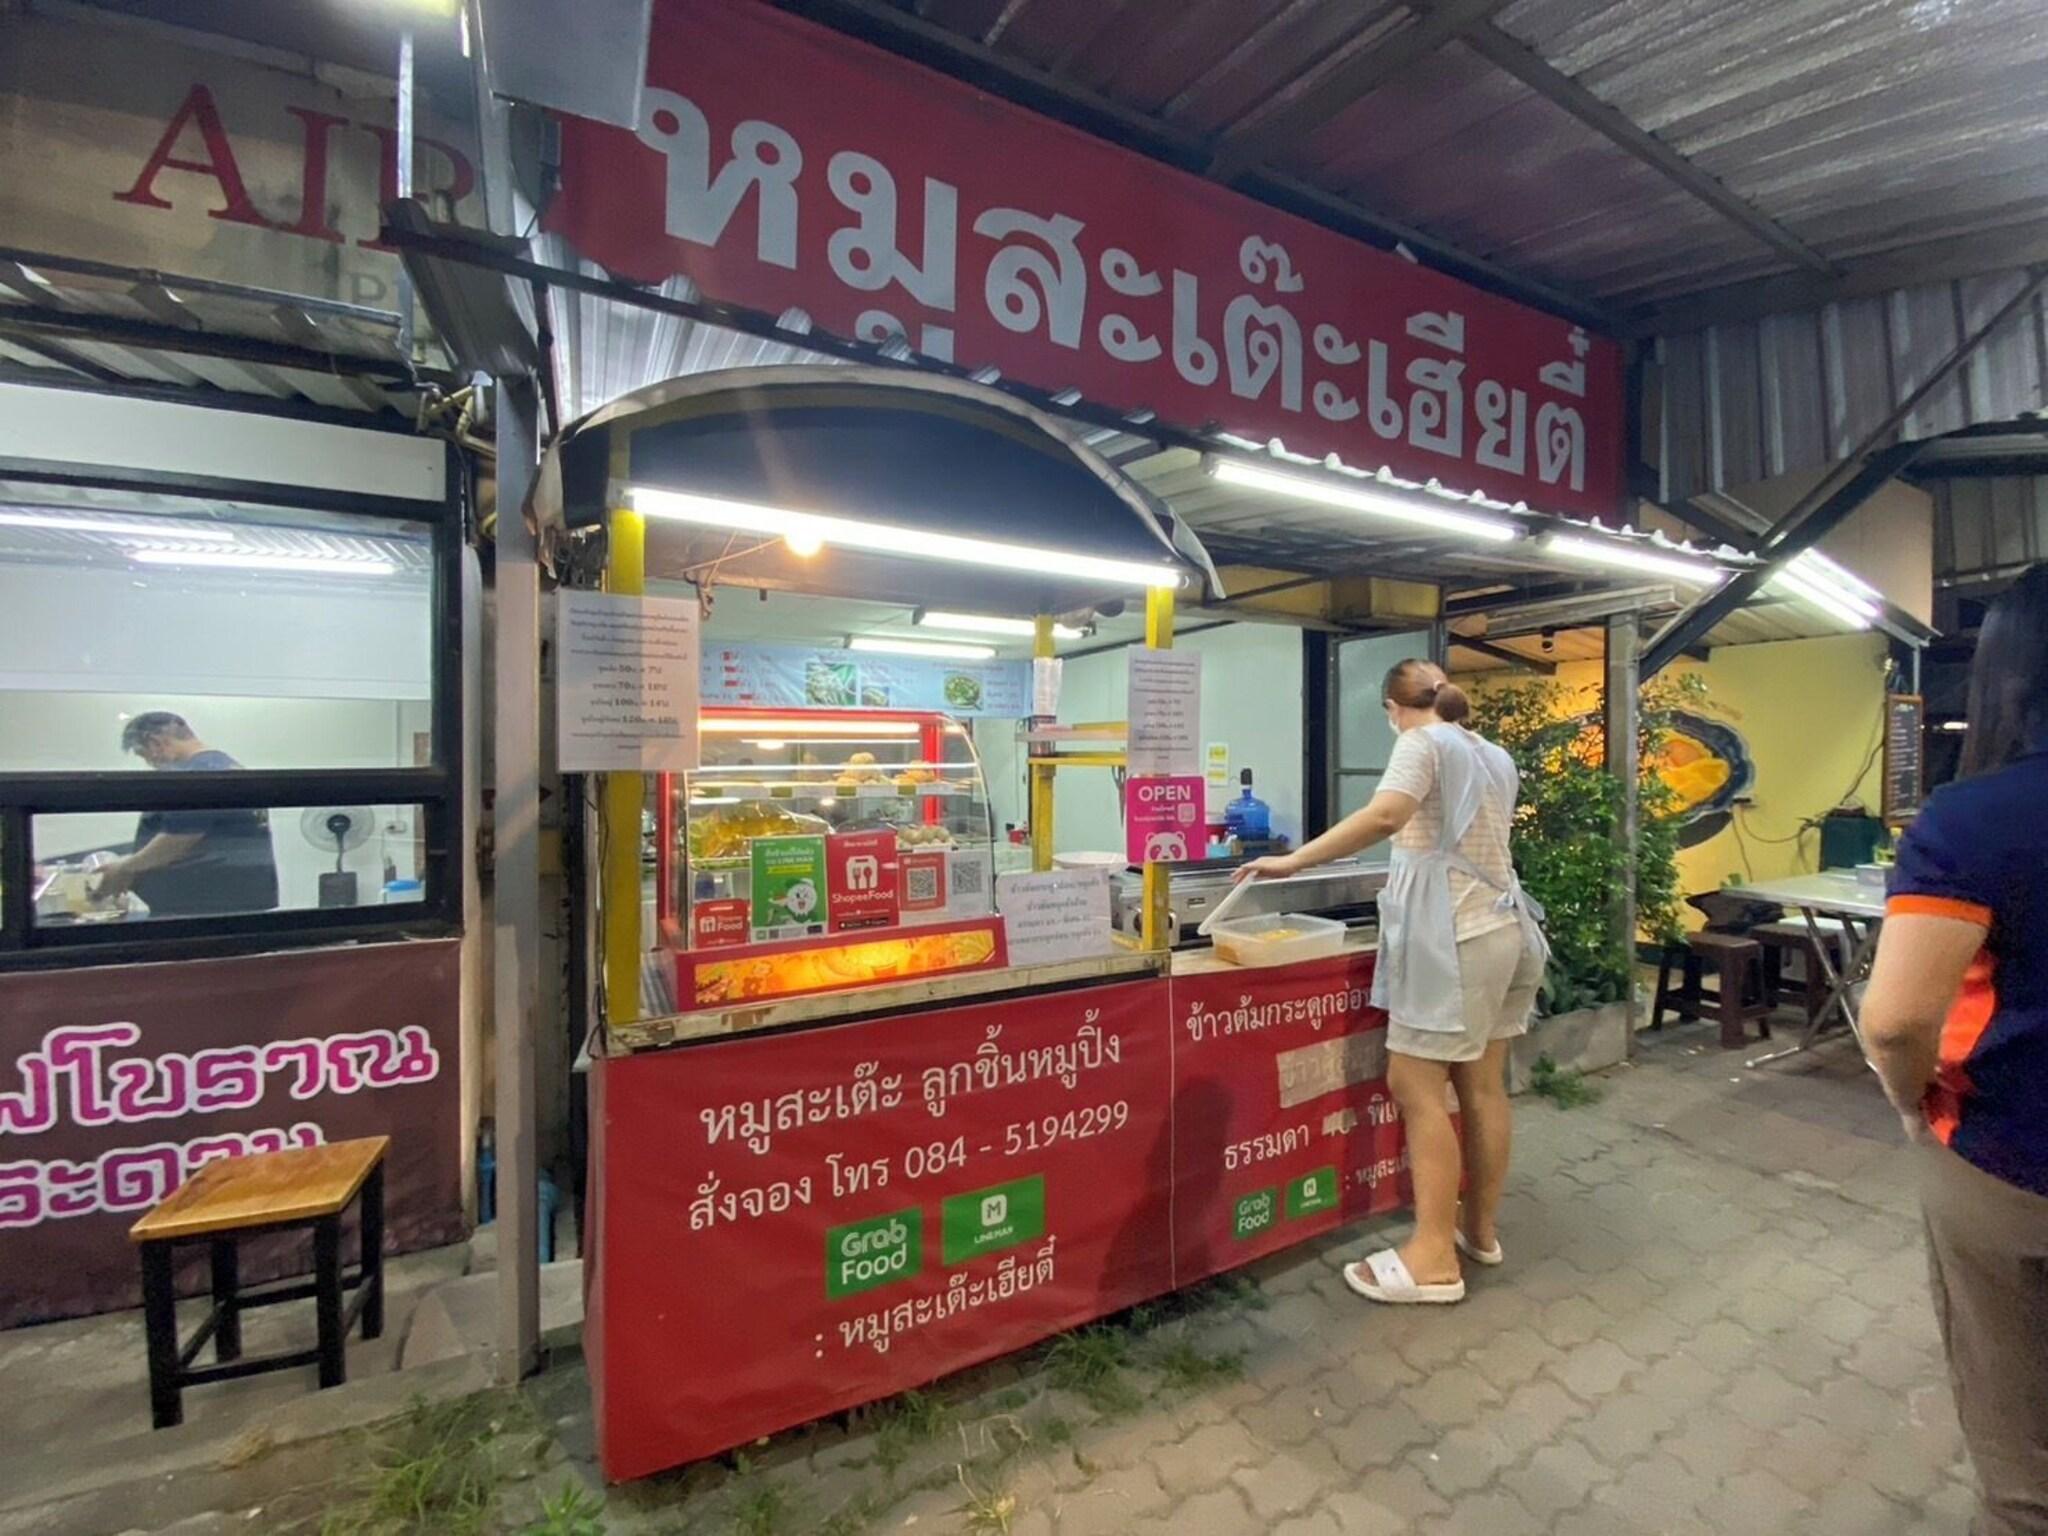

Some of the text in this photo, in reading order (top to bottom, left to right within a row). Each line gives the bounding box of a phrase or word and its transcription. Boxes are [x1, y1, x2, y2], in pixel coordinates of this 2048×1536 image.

[1138, 785, 1191, 802] OPEN
[832, 889, 894, 905] ShopeeFood
[700, 1008, 1121, 1155] หมูสะเต๊ะ ลูกชิ้นหมูปิ้ง
[688, 1171, 812, 1230] สั่งจอง
[826, 1153, 889, 1198] โทร
[905, 1136, 967, 1179] 084
[1005, 1100, 1129, 1156] 5194299
[1223, 1123, 1309, 1170] ธรรมดา
[1238, 1193, 1270, 1216] Grab
[1238, 1209, 1270, 1233] Food
[841, 1218, 908, 1258] Grab
[841, 1246, 908, 1285] Food
[838, 1234, 1058, 1354] หมูสะเต๊ะเฮียตี๋
